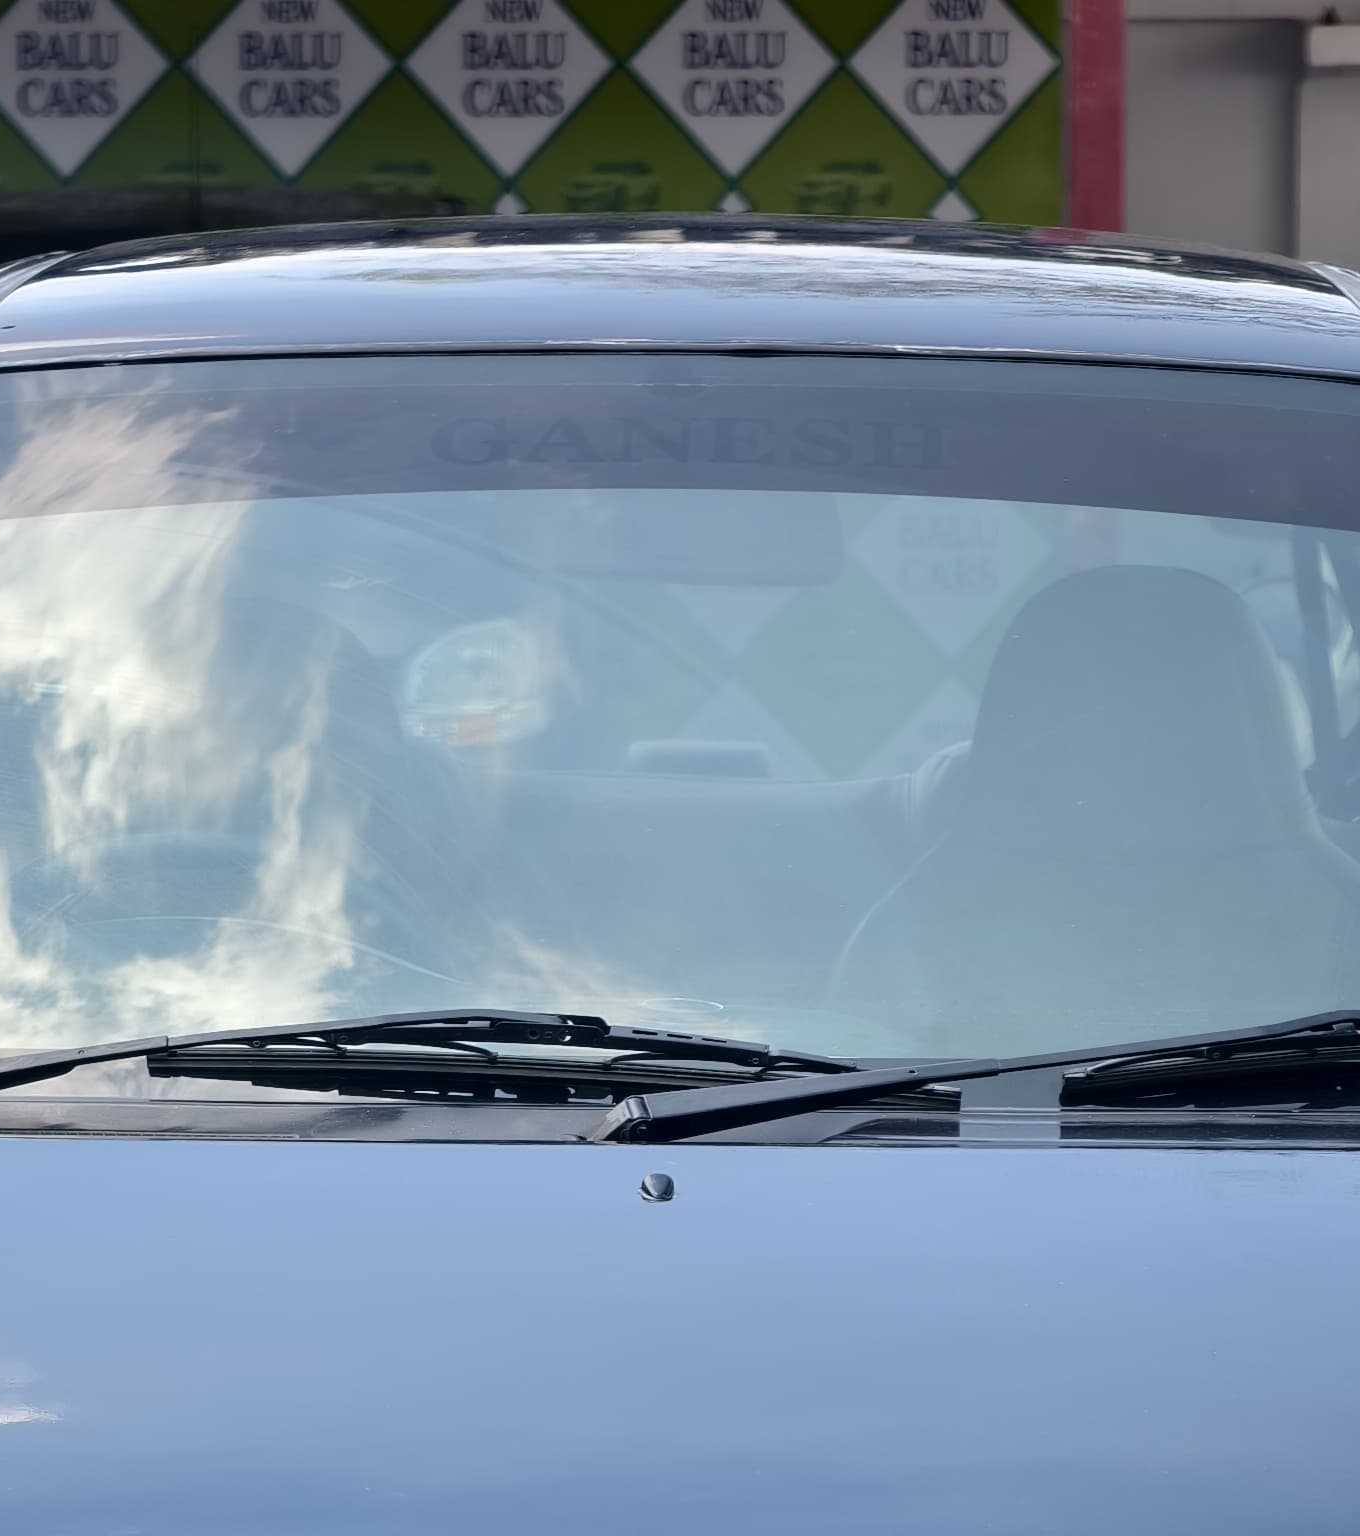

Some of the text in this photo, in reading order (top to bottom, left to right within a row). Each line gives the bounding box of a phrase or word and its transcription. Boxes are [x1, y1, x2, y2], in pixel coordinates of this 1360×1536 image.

[39, 0, 93, 22] NEW
[262, 0, 317, 22] NEW
[486, 0, 540, 22] NEW
[706, 0, 763, 22] NEW
[929, 0, 984, 22] NEW
[14, 31, 120, 70] BALU
[238, 31, 343, 70] BALU
[462, 31, 567, 70] BALU
[682, 31, 787, 70] BALU
[904, 31, 1010, 70] BALU
[15, 78, 118, 117] CARS
[239, 78, 341, 117] CARS
[463, 78, 565, 117] CARS
[682, 78, 786, 117] CARS
[905, 78, 1007, 117] CARS
[430, 414, 954, 470] GANESH
